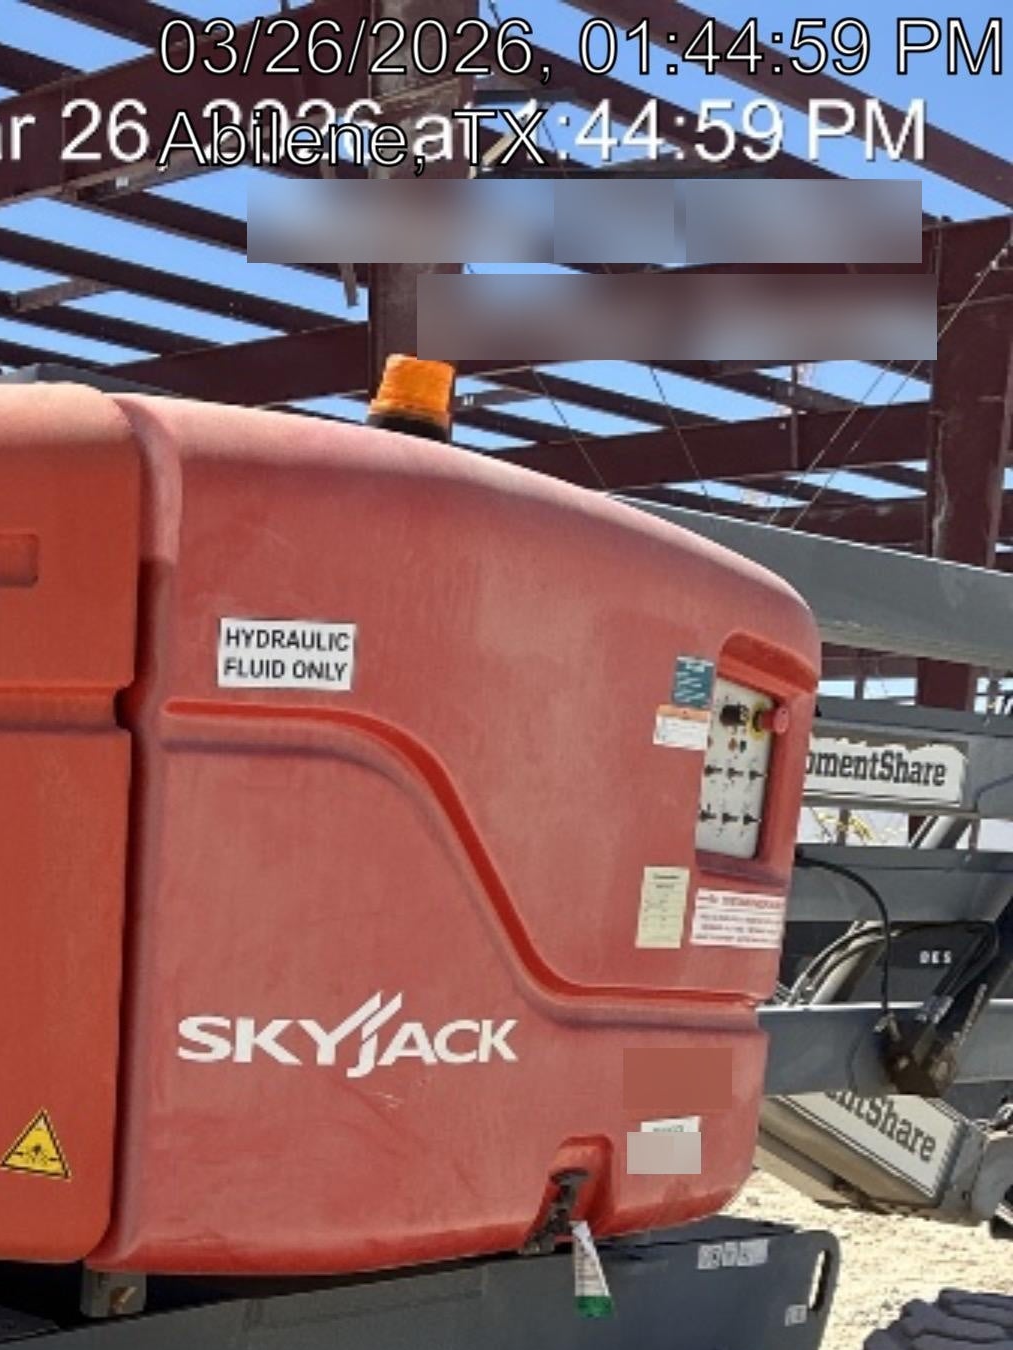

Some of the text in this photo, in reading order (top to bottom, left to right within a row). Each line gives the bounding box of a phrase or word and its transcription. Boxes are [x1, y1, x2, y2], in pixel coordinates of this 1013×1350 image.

[225, 626, 351, 652] HYDRAULIC
[224, 656, 348, 682] FLUID ONLY
[177, 990, 519, 1078] SKYJACK
